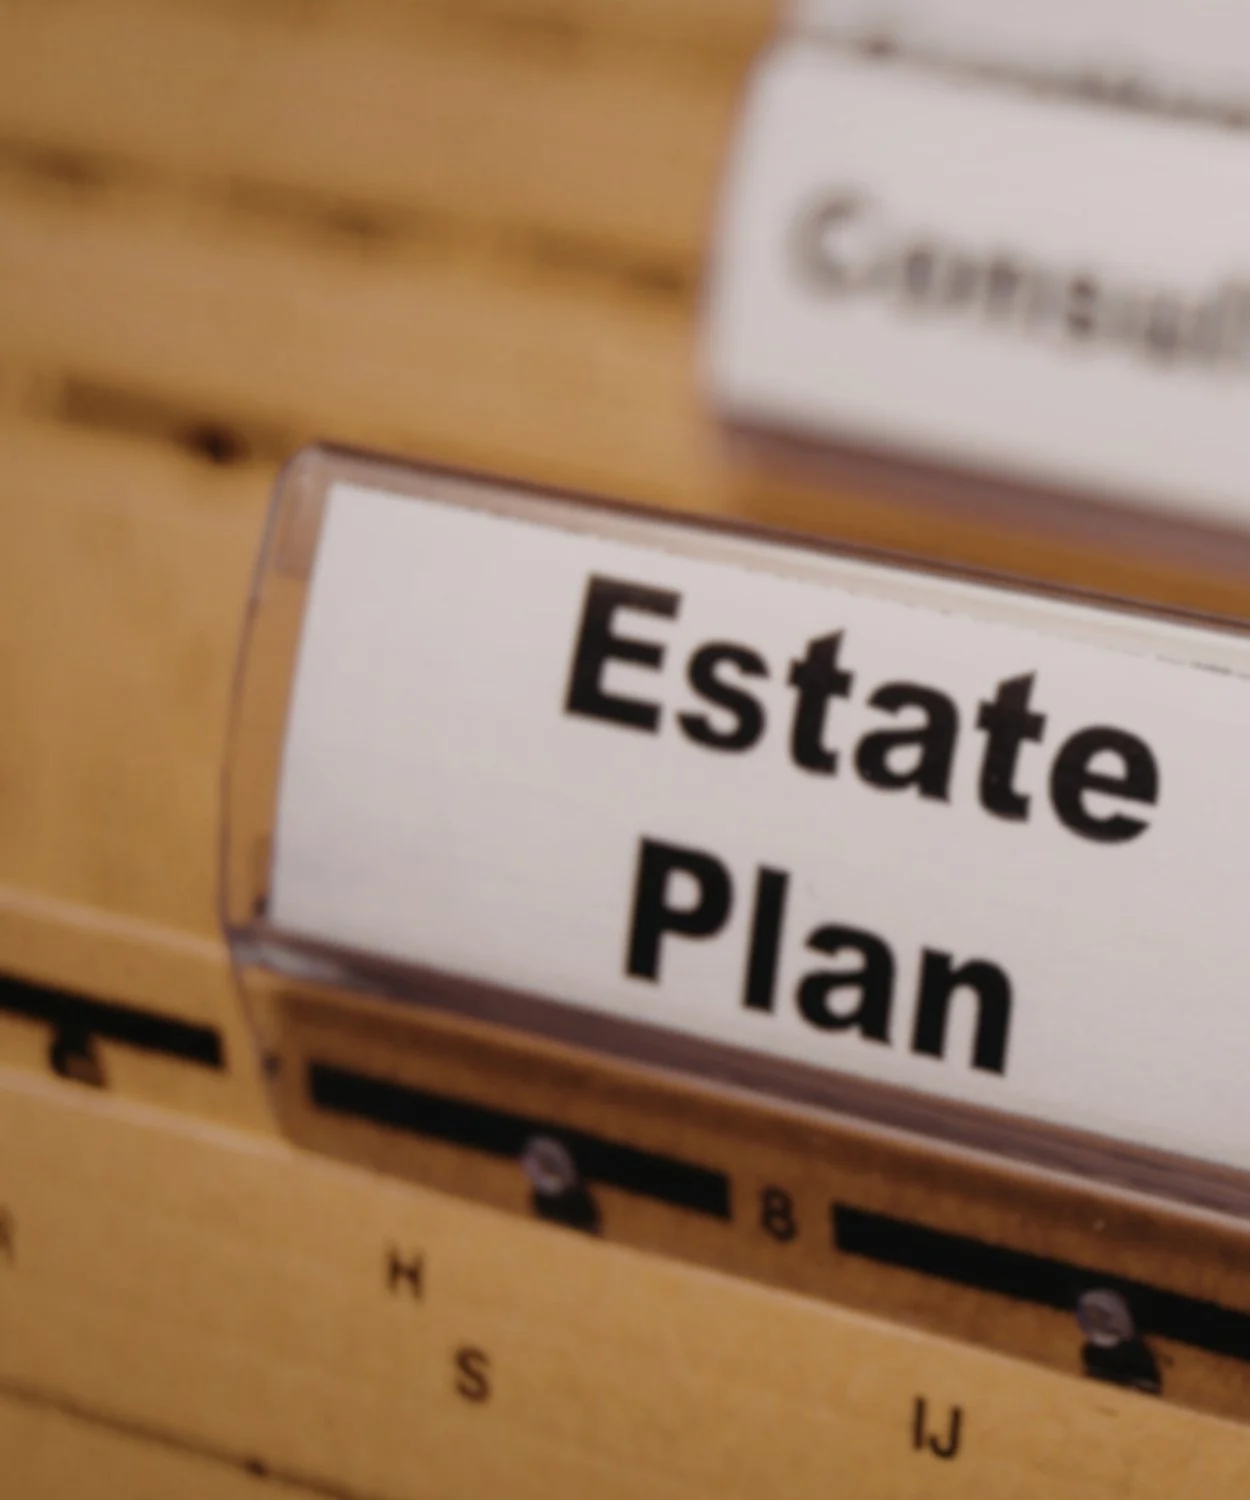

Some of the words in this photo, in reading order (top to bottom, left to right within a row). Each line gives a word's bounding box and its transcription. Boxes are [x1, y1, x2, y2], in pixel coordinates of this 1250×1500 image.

[562, 572, 1161, 845] Estate
[624, 834, 1014, 1078] Plan
[758, 1186, 798, 1244] 8
[386, 1243, 425, 1300] H
[455, 1346, 491, 1402] S
[911, 1395, 963, 1460] IJ
